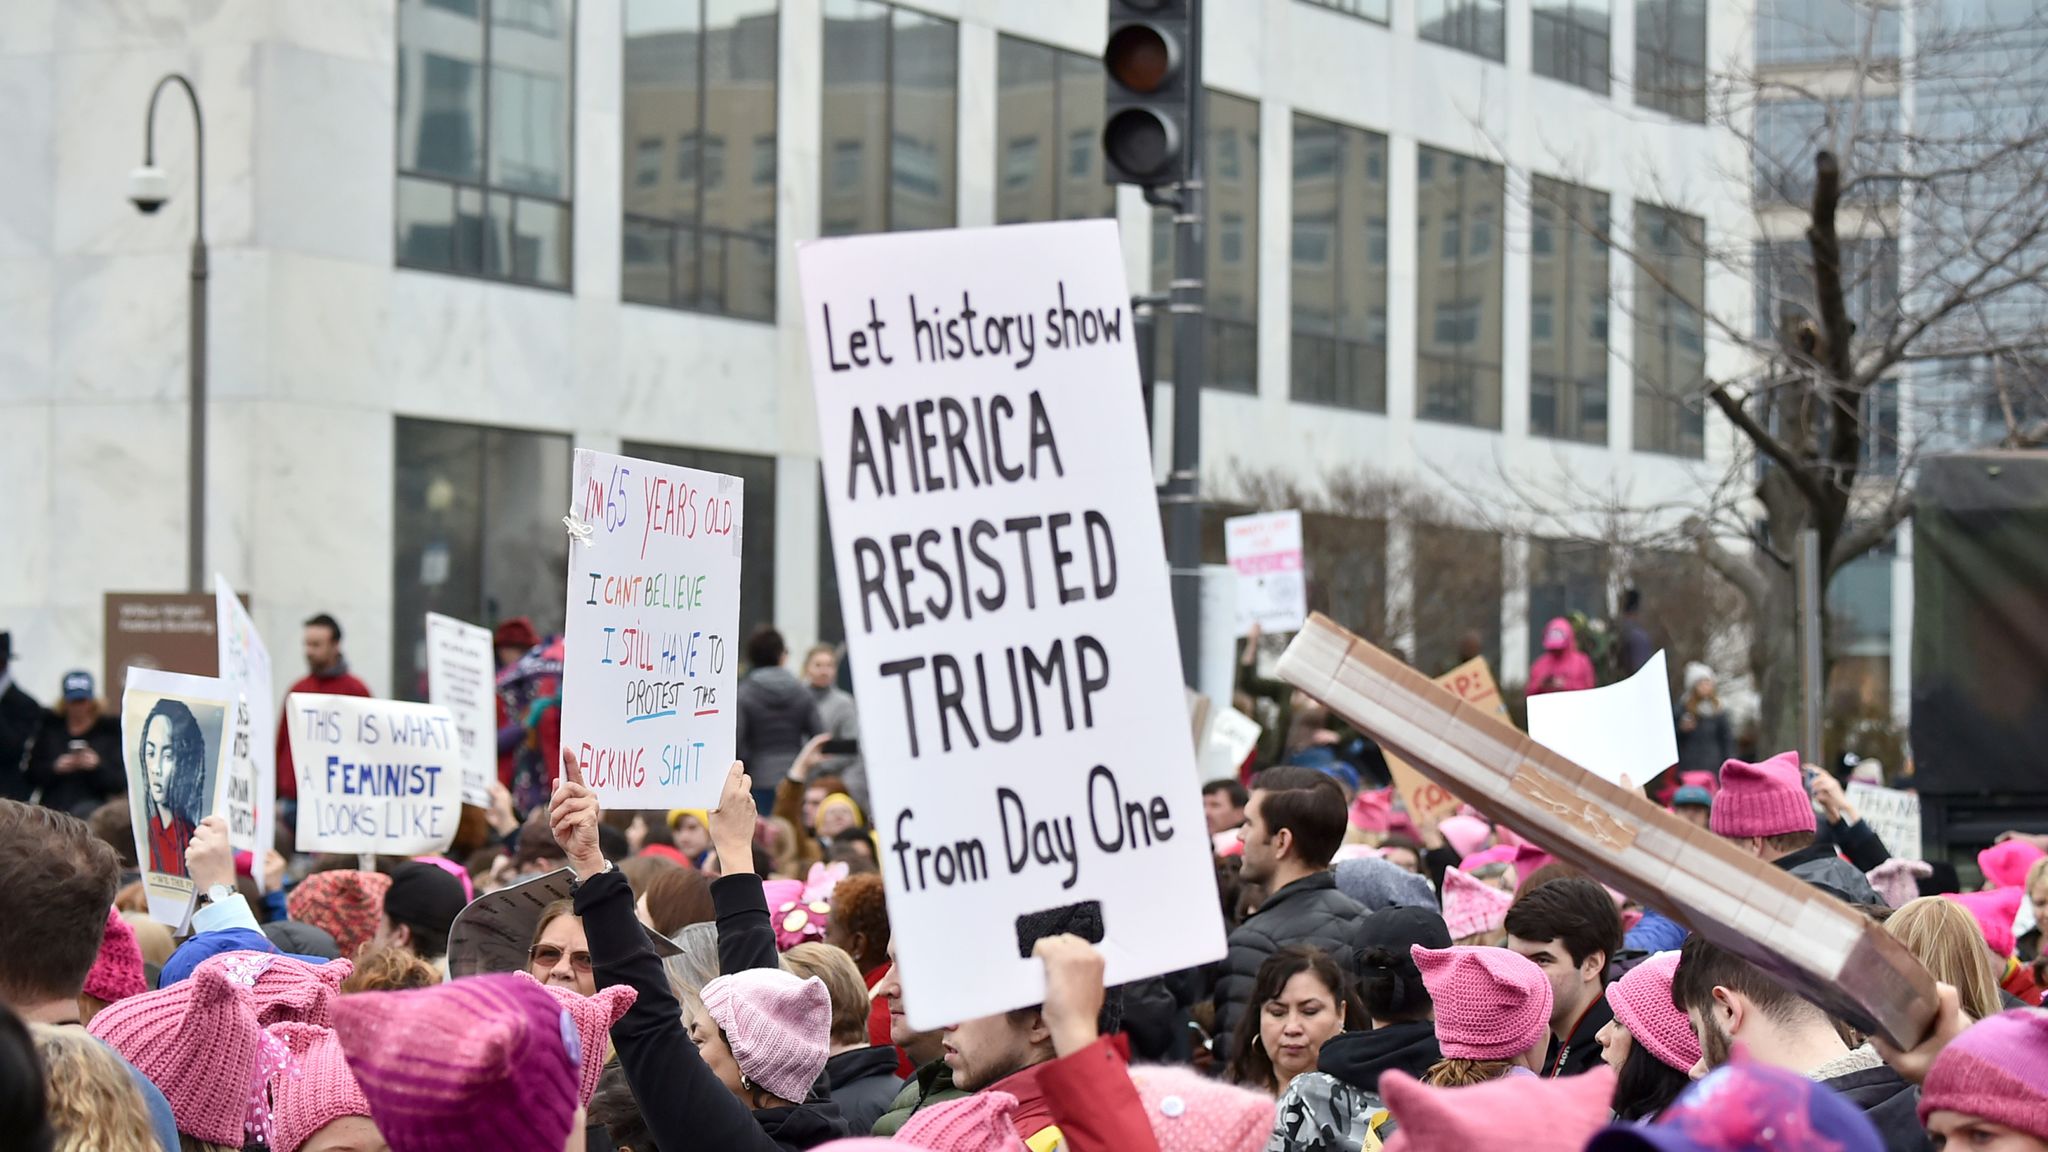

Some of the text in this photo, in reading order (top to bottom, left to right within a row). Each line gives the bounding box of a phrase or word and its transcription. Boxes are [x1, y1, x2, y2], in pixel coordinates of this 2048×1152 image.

[823, 281, 1121, 372] Let history show
[848, 390, 1064, 500] AMERICA
[606, 464, 630, 533] 65
[641, 476, 698, 560] YEARS
[704, 497, 732, 535] OLD
[586, 572, 602, 606] I
[644, 573, 706, 611] BELIEVE
[854, 510, 1118, 633] RESISTED
[601, 627, 616, 664] I
[660, 631, 701, 677] HAVE
[708, 634, 725, 674] TO
[626, 679, 717, 715] PROTEST THIS
[880, 634, 1110, 758] TRUMP
[302, 709, 342, 745] THIS
[357, 714, 380, 745] IS
[388, 714, 449, 749] WHAT
[302, 765, 315, 790] A
[327, 756, 442, 797] FEMINIST
[579, 742, 647, 792] FUCKING
[315, 798, 444, 840] LOOKS LIKE
[892, 764, 1174, 892] from Day One
